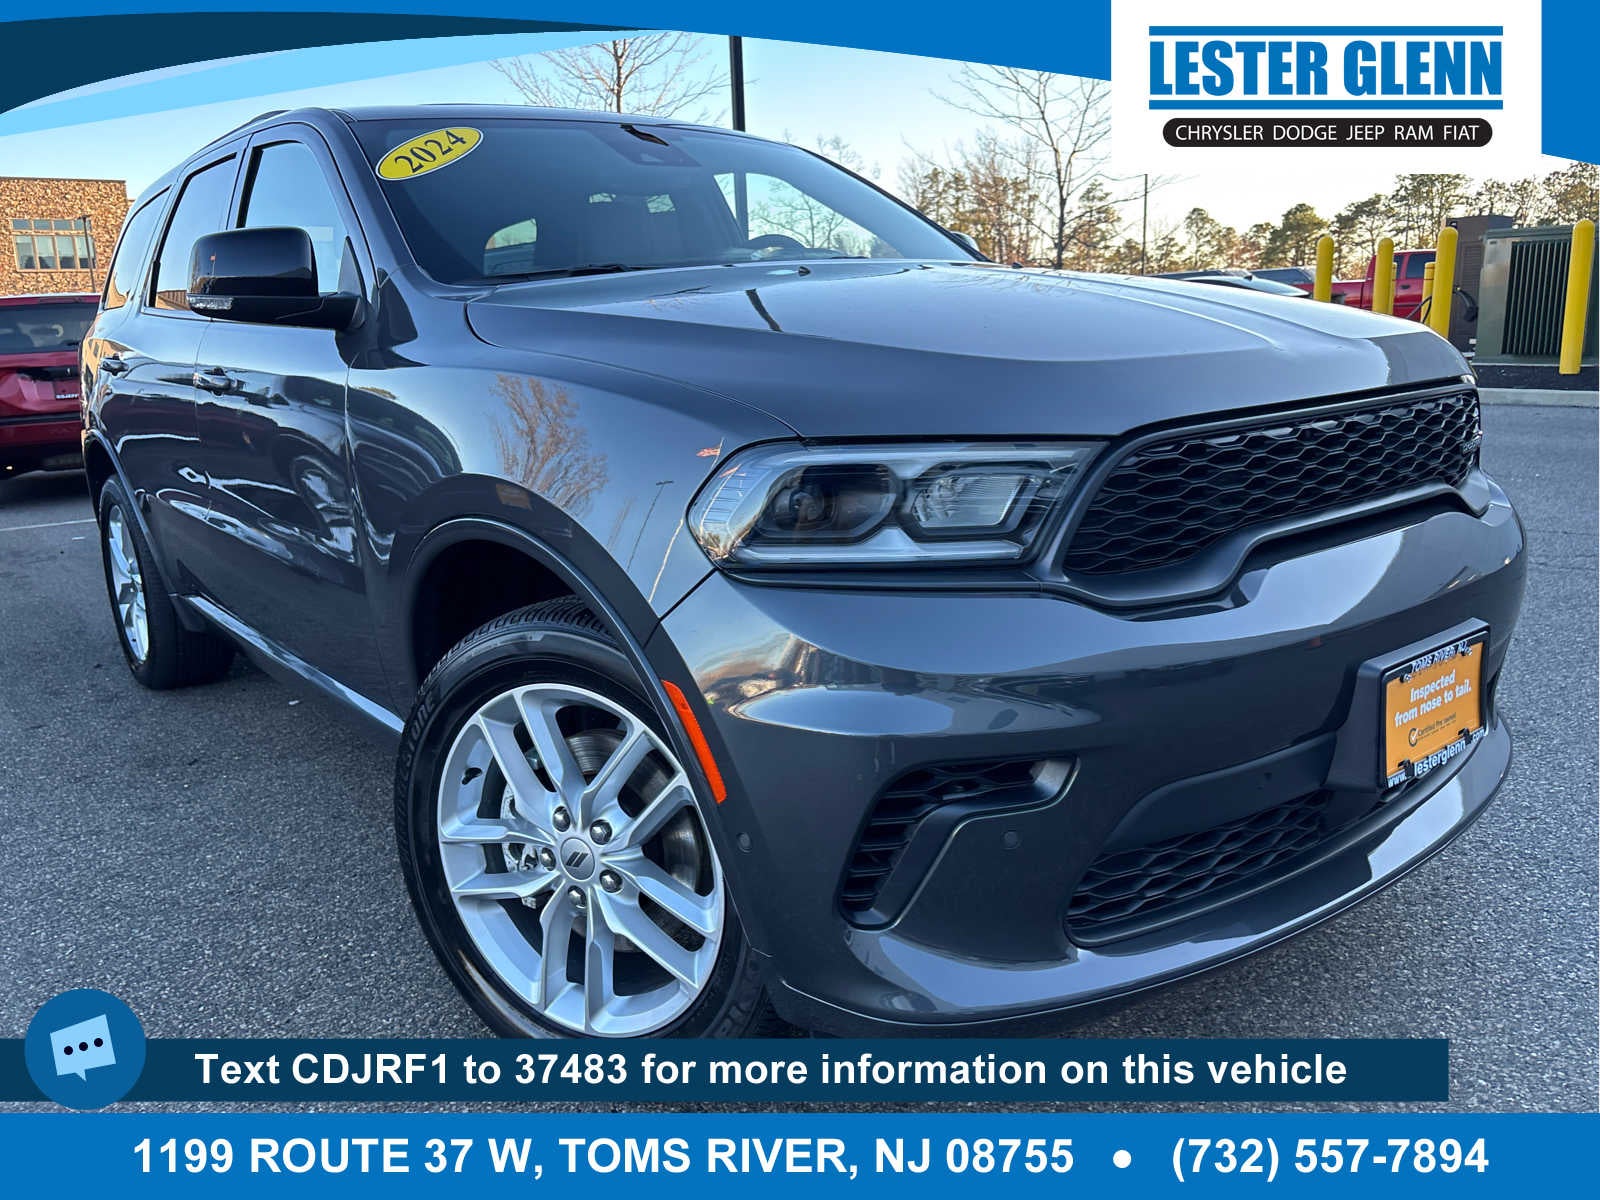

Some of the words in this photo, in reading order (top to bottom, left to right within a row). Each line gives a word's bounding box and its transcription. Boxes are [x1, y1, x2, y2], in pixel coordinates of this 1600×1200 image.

[394, 130, 467, 173] 2024
[1394, 706, 1418, 727] from
[1419, 696, 1443, 716] nose
[1443, 690, 1454, 703] to
[1454, 679, 1472, 699] tail.
[1411, 669, 1455, 702] Inspected
[1414, 741, 1466, 777] lesterglenn
